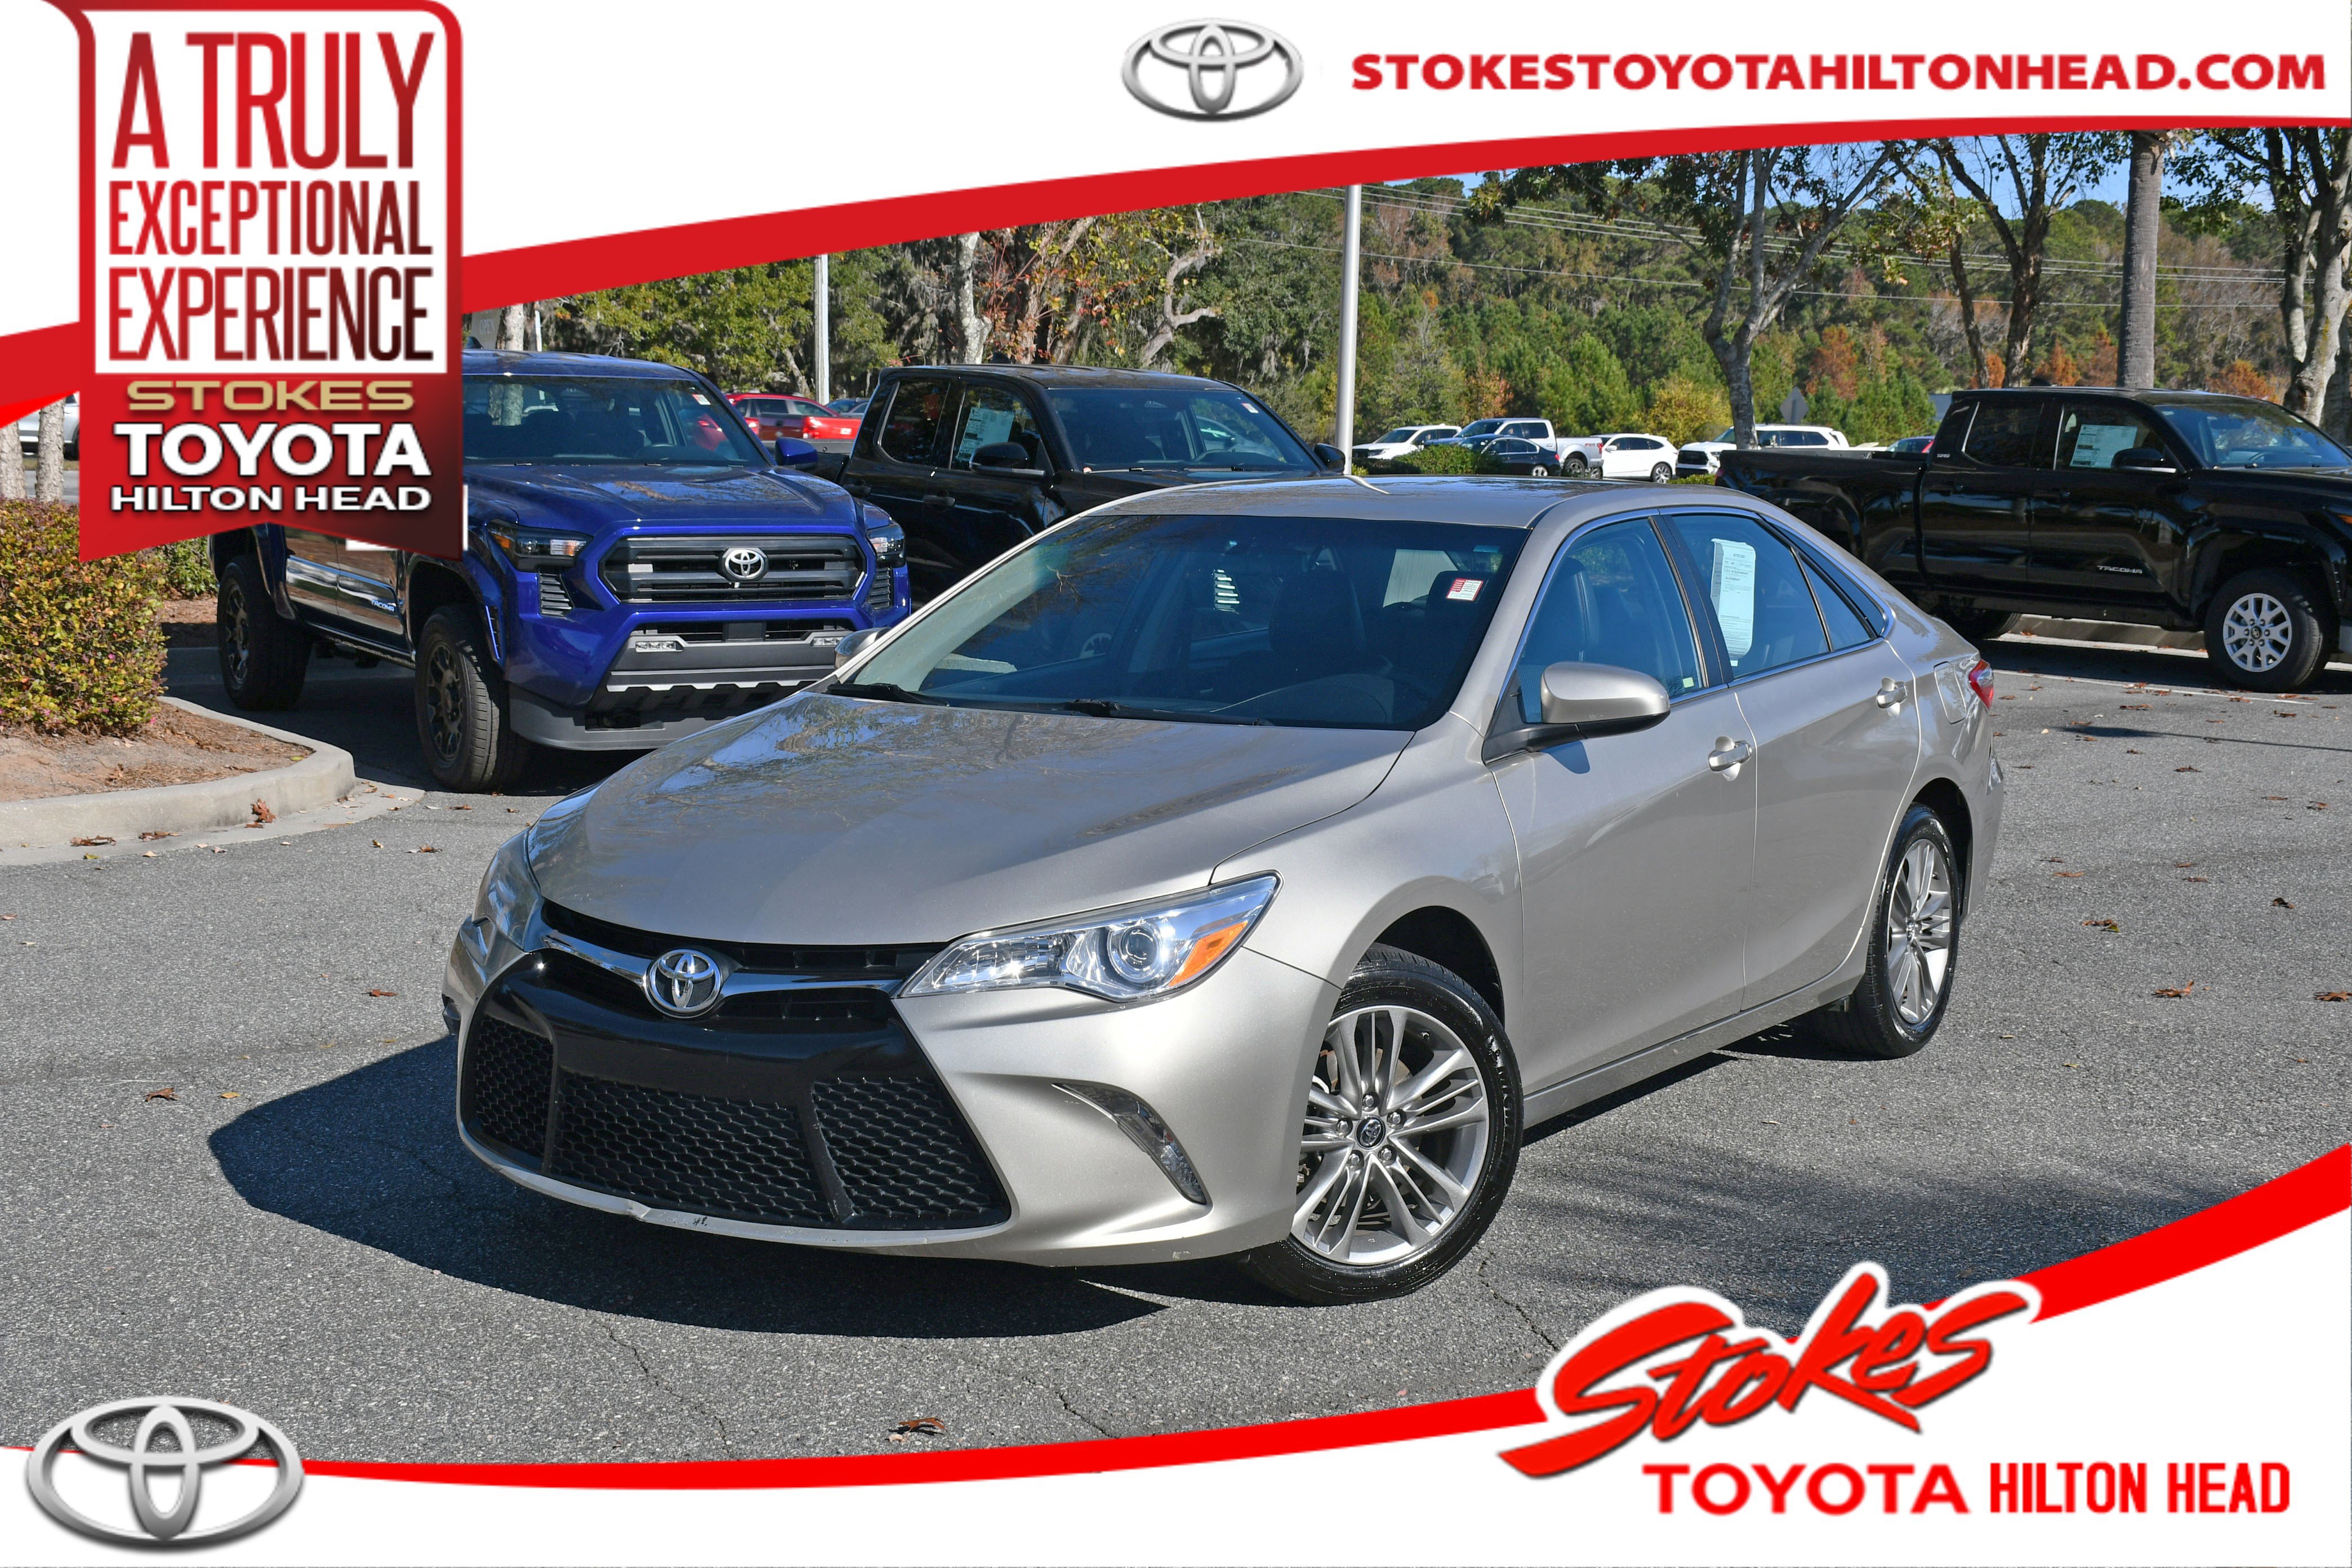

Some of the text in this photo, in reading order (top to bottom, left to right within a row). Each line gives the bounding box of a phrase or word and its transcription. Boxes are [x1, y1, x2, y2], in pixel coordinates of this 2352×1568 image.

[479, 318, 495, 335] OPEN
[2097, 565, 2142, 574] TACOMA
[372, 600, 394, 612] TACOMA
